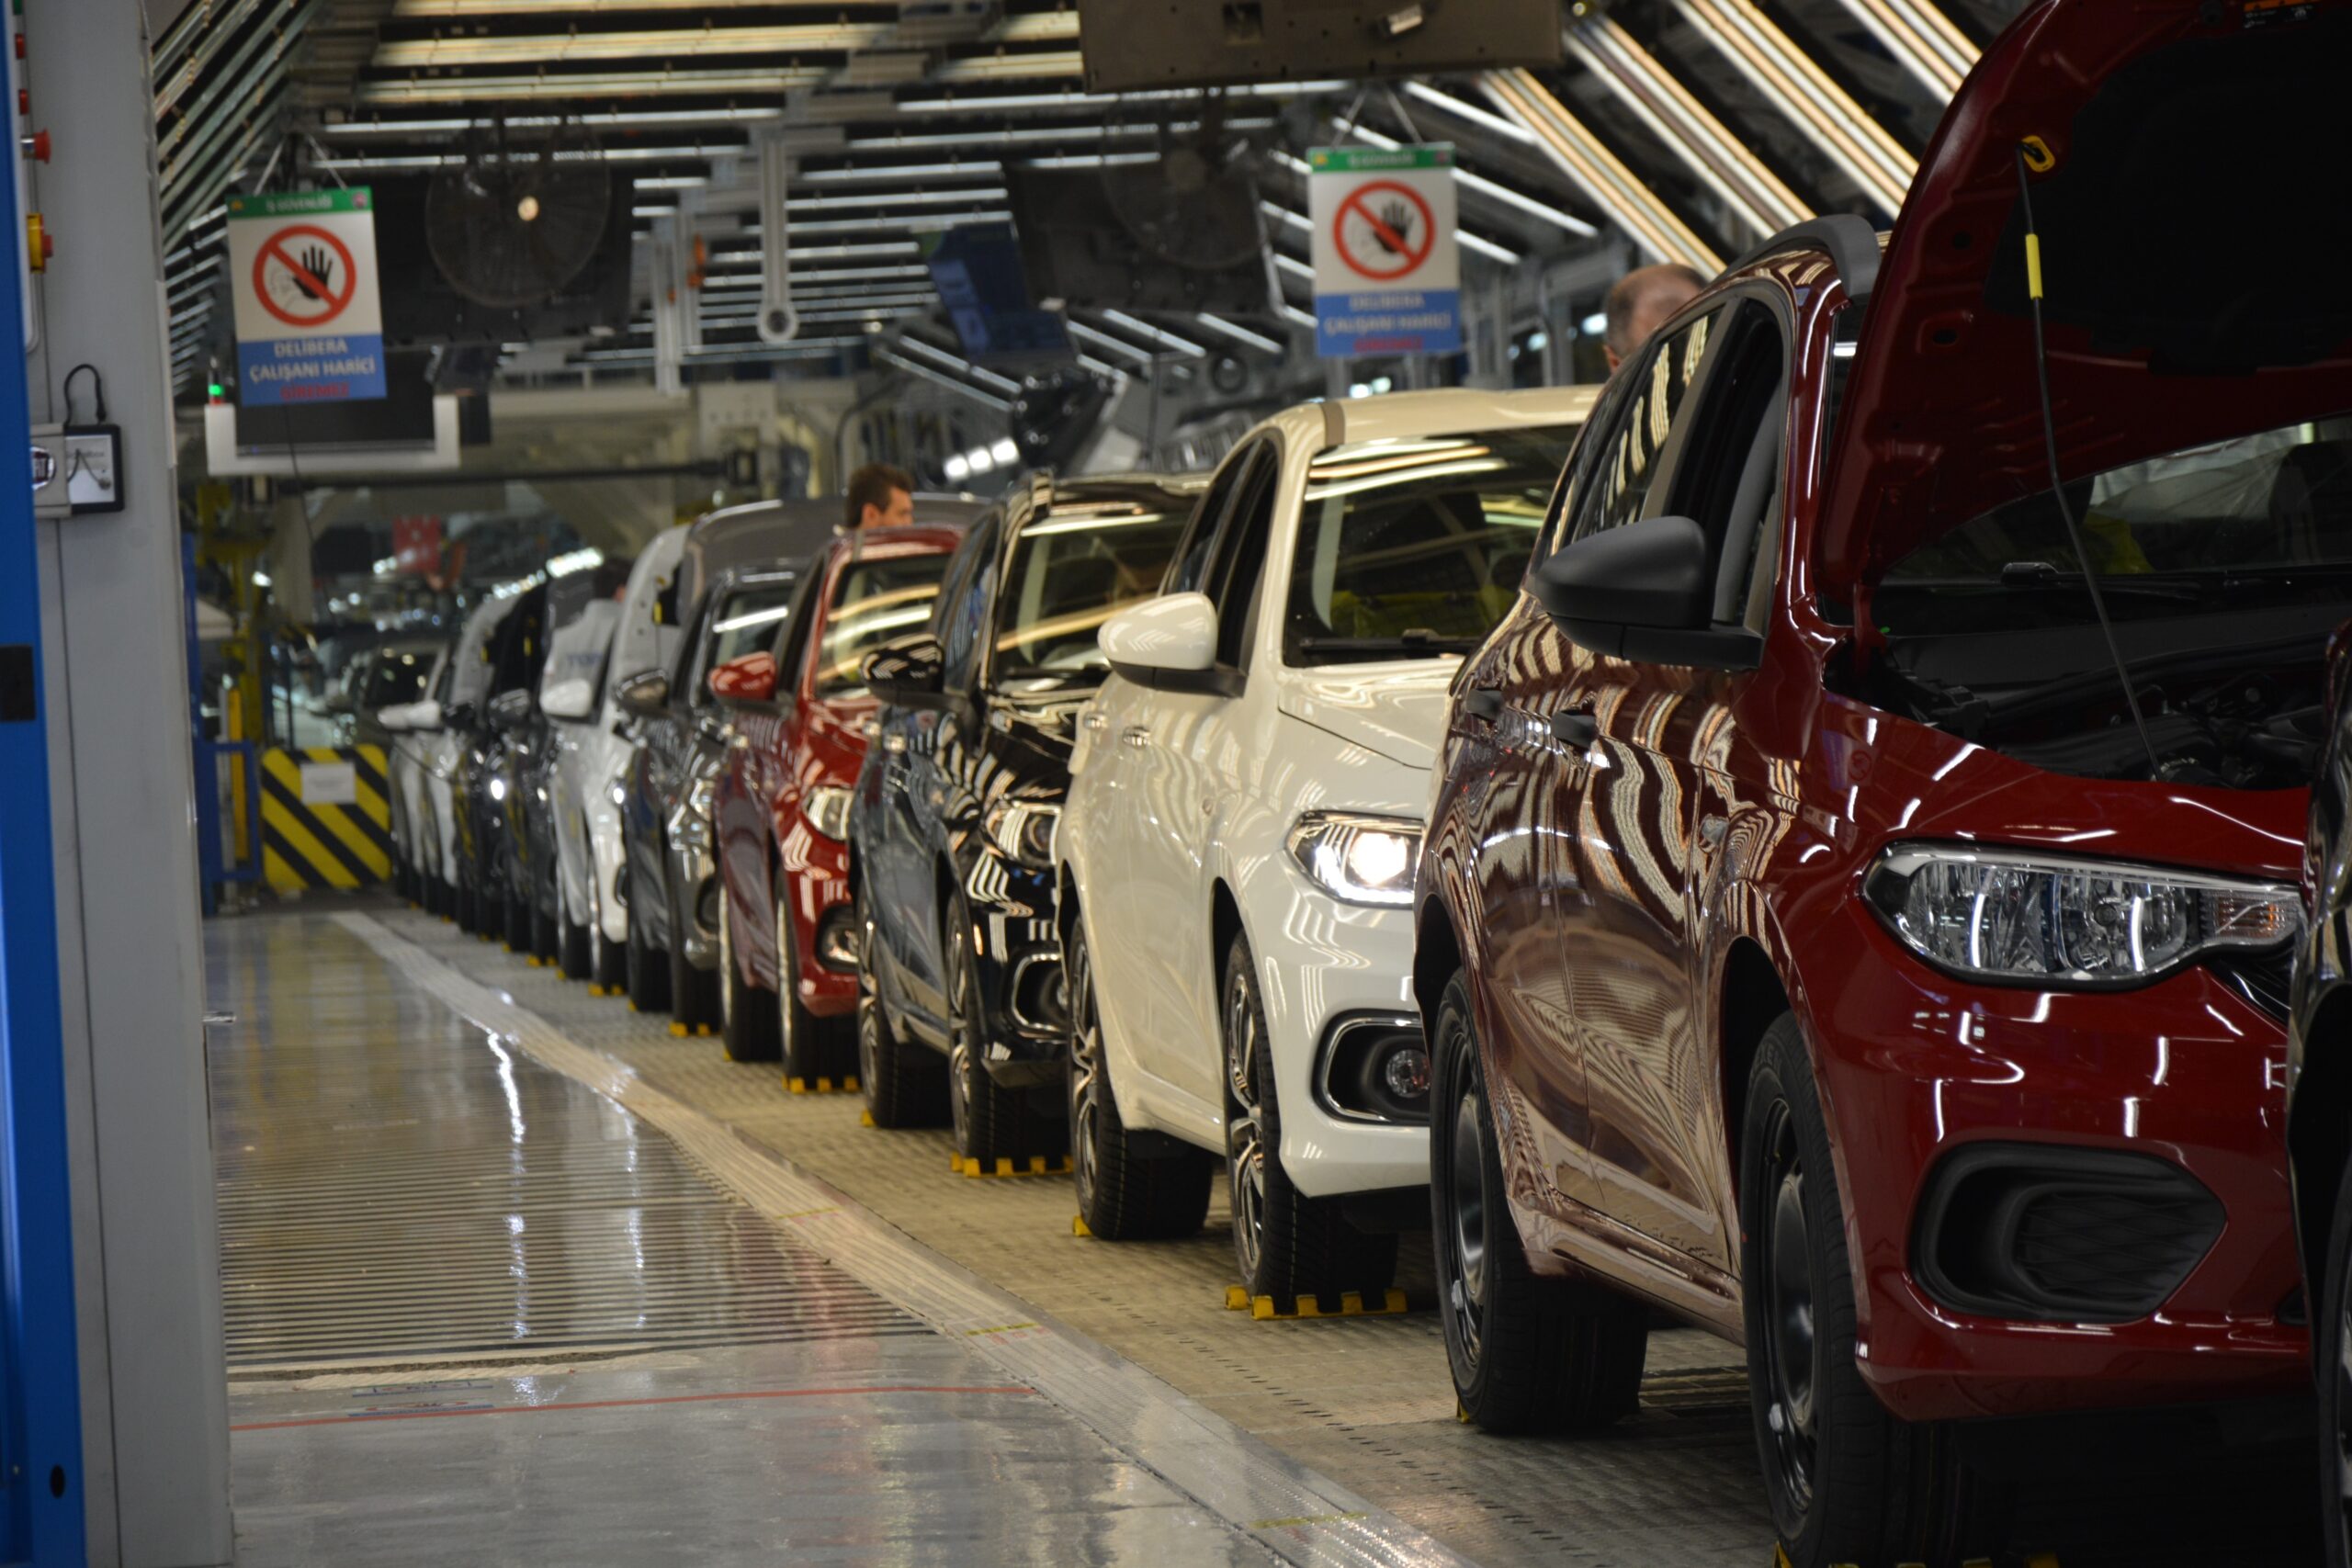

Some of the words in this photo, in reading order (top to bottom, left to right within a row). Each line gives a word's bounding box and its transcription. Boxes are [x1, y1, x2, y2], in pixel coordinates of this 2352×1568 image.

[275, 338, 347, 356] DELİBERA
[250, 360, 319, 383] ÇALIŞANI
[323, 355, 376, 376] HARİCİ
